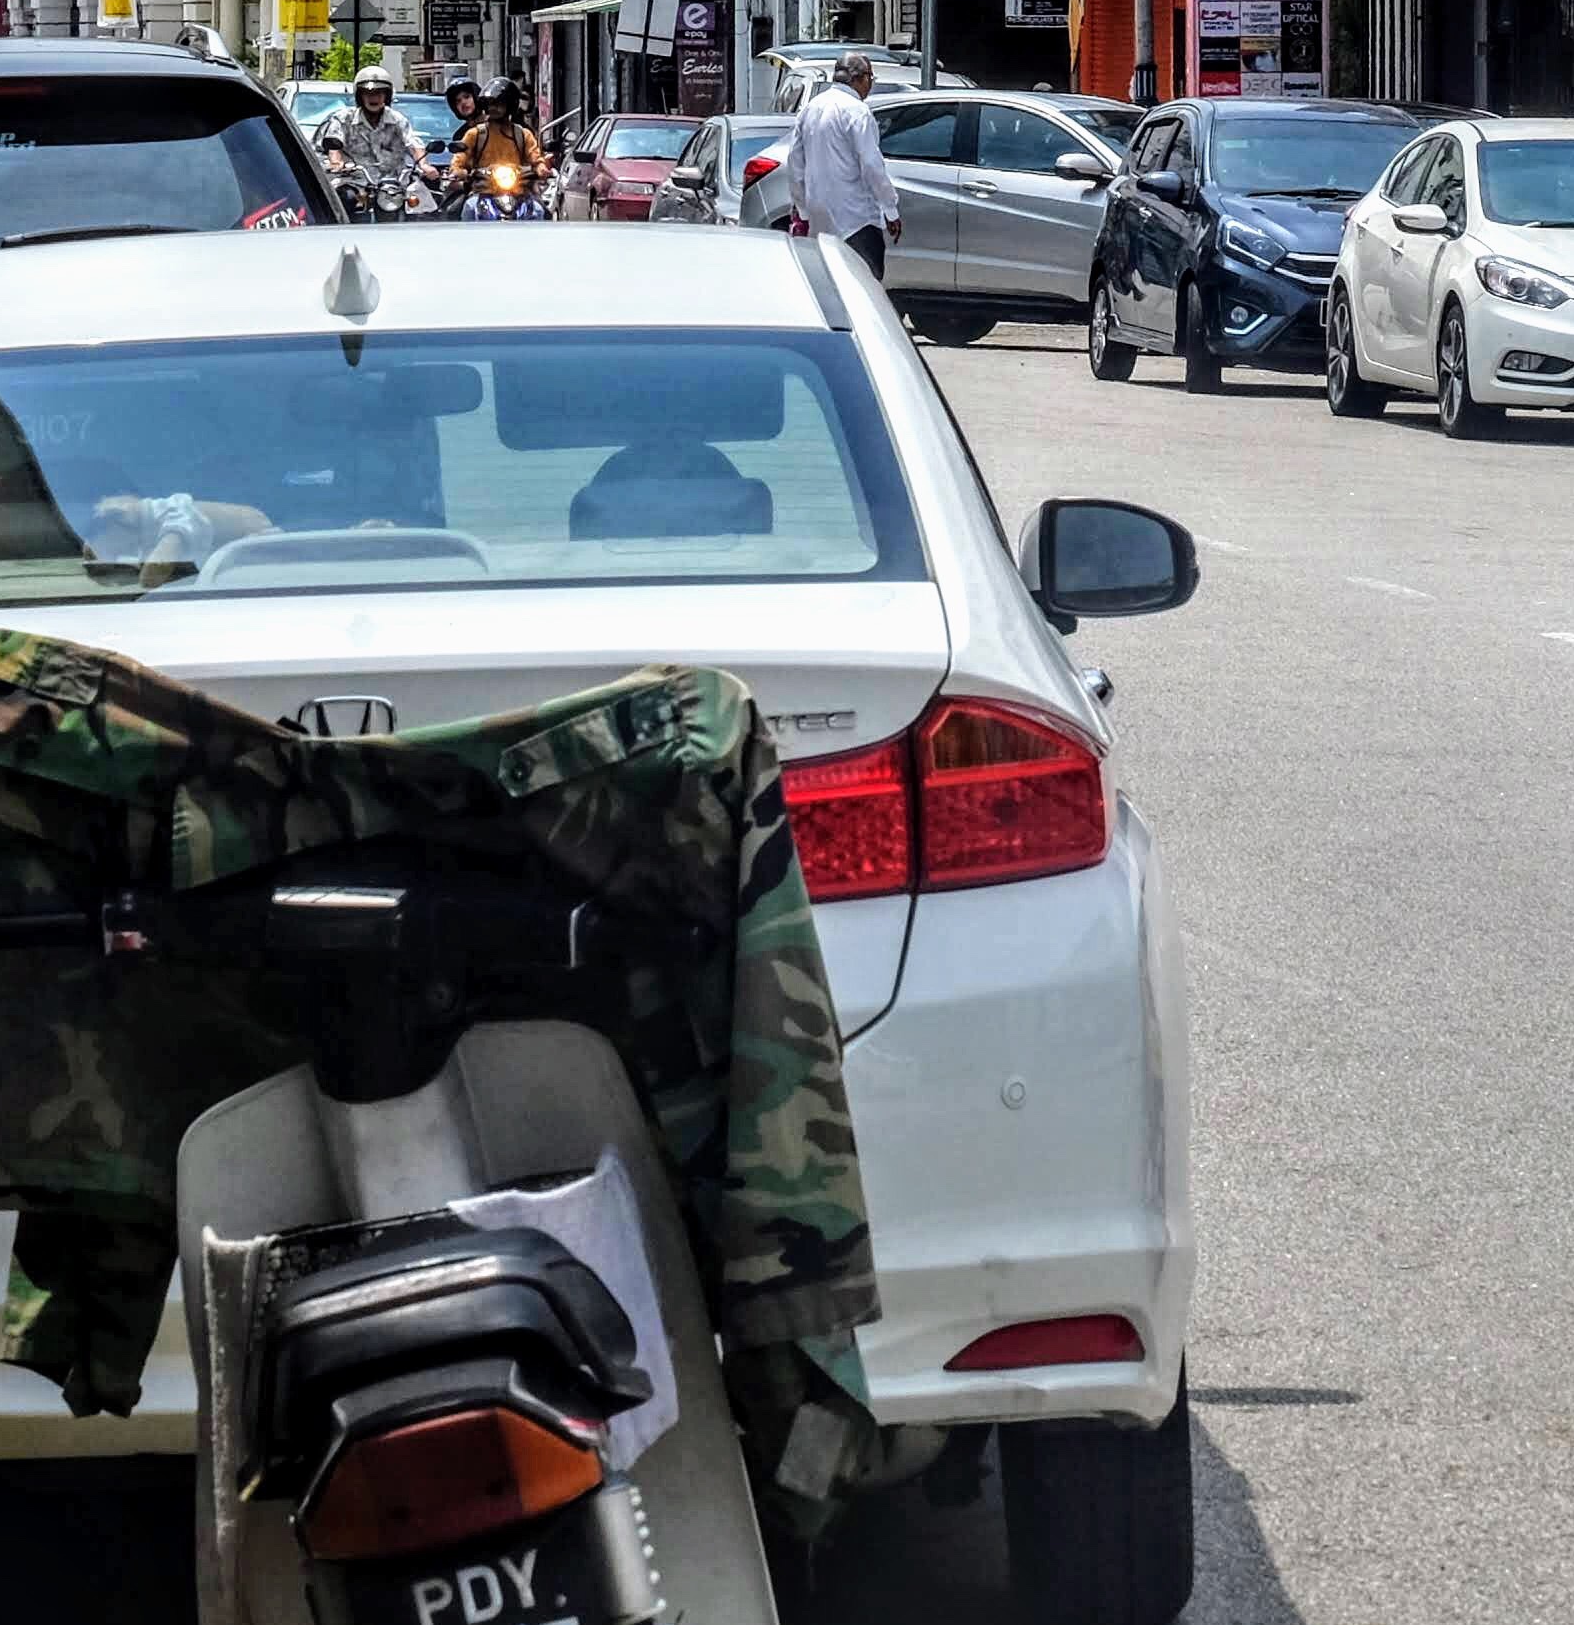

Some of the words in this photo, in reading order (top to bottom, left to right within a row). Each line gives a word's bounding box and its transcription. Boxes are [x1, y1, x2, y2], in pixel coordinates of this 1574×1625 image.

[1289, 2, 1313, 12] STAR
[1282, 13, 1319, 24] OPTICAL
[766, 709, 856, 733] TEC
